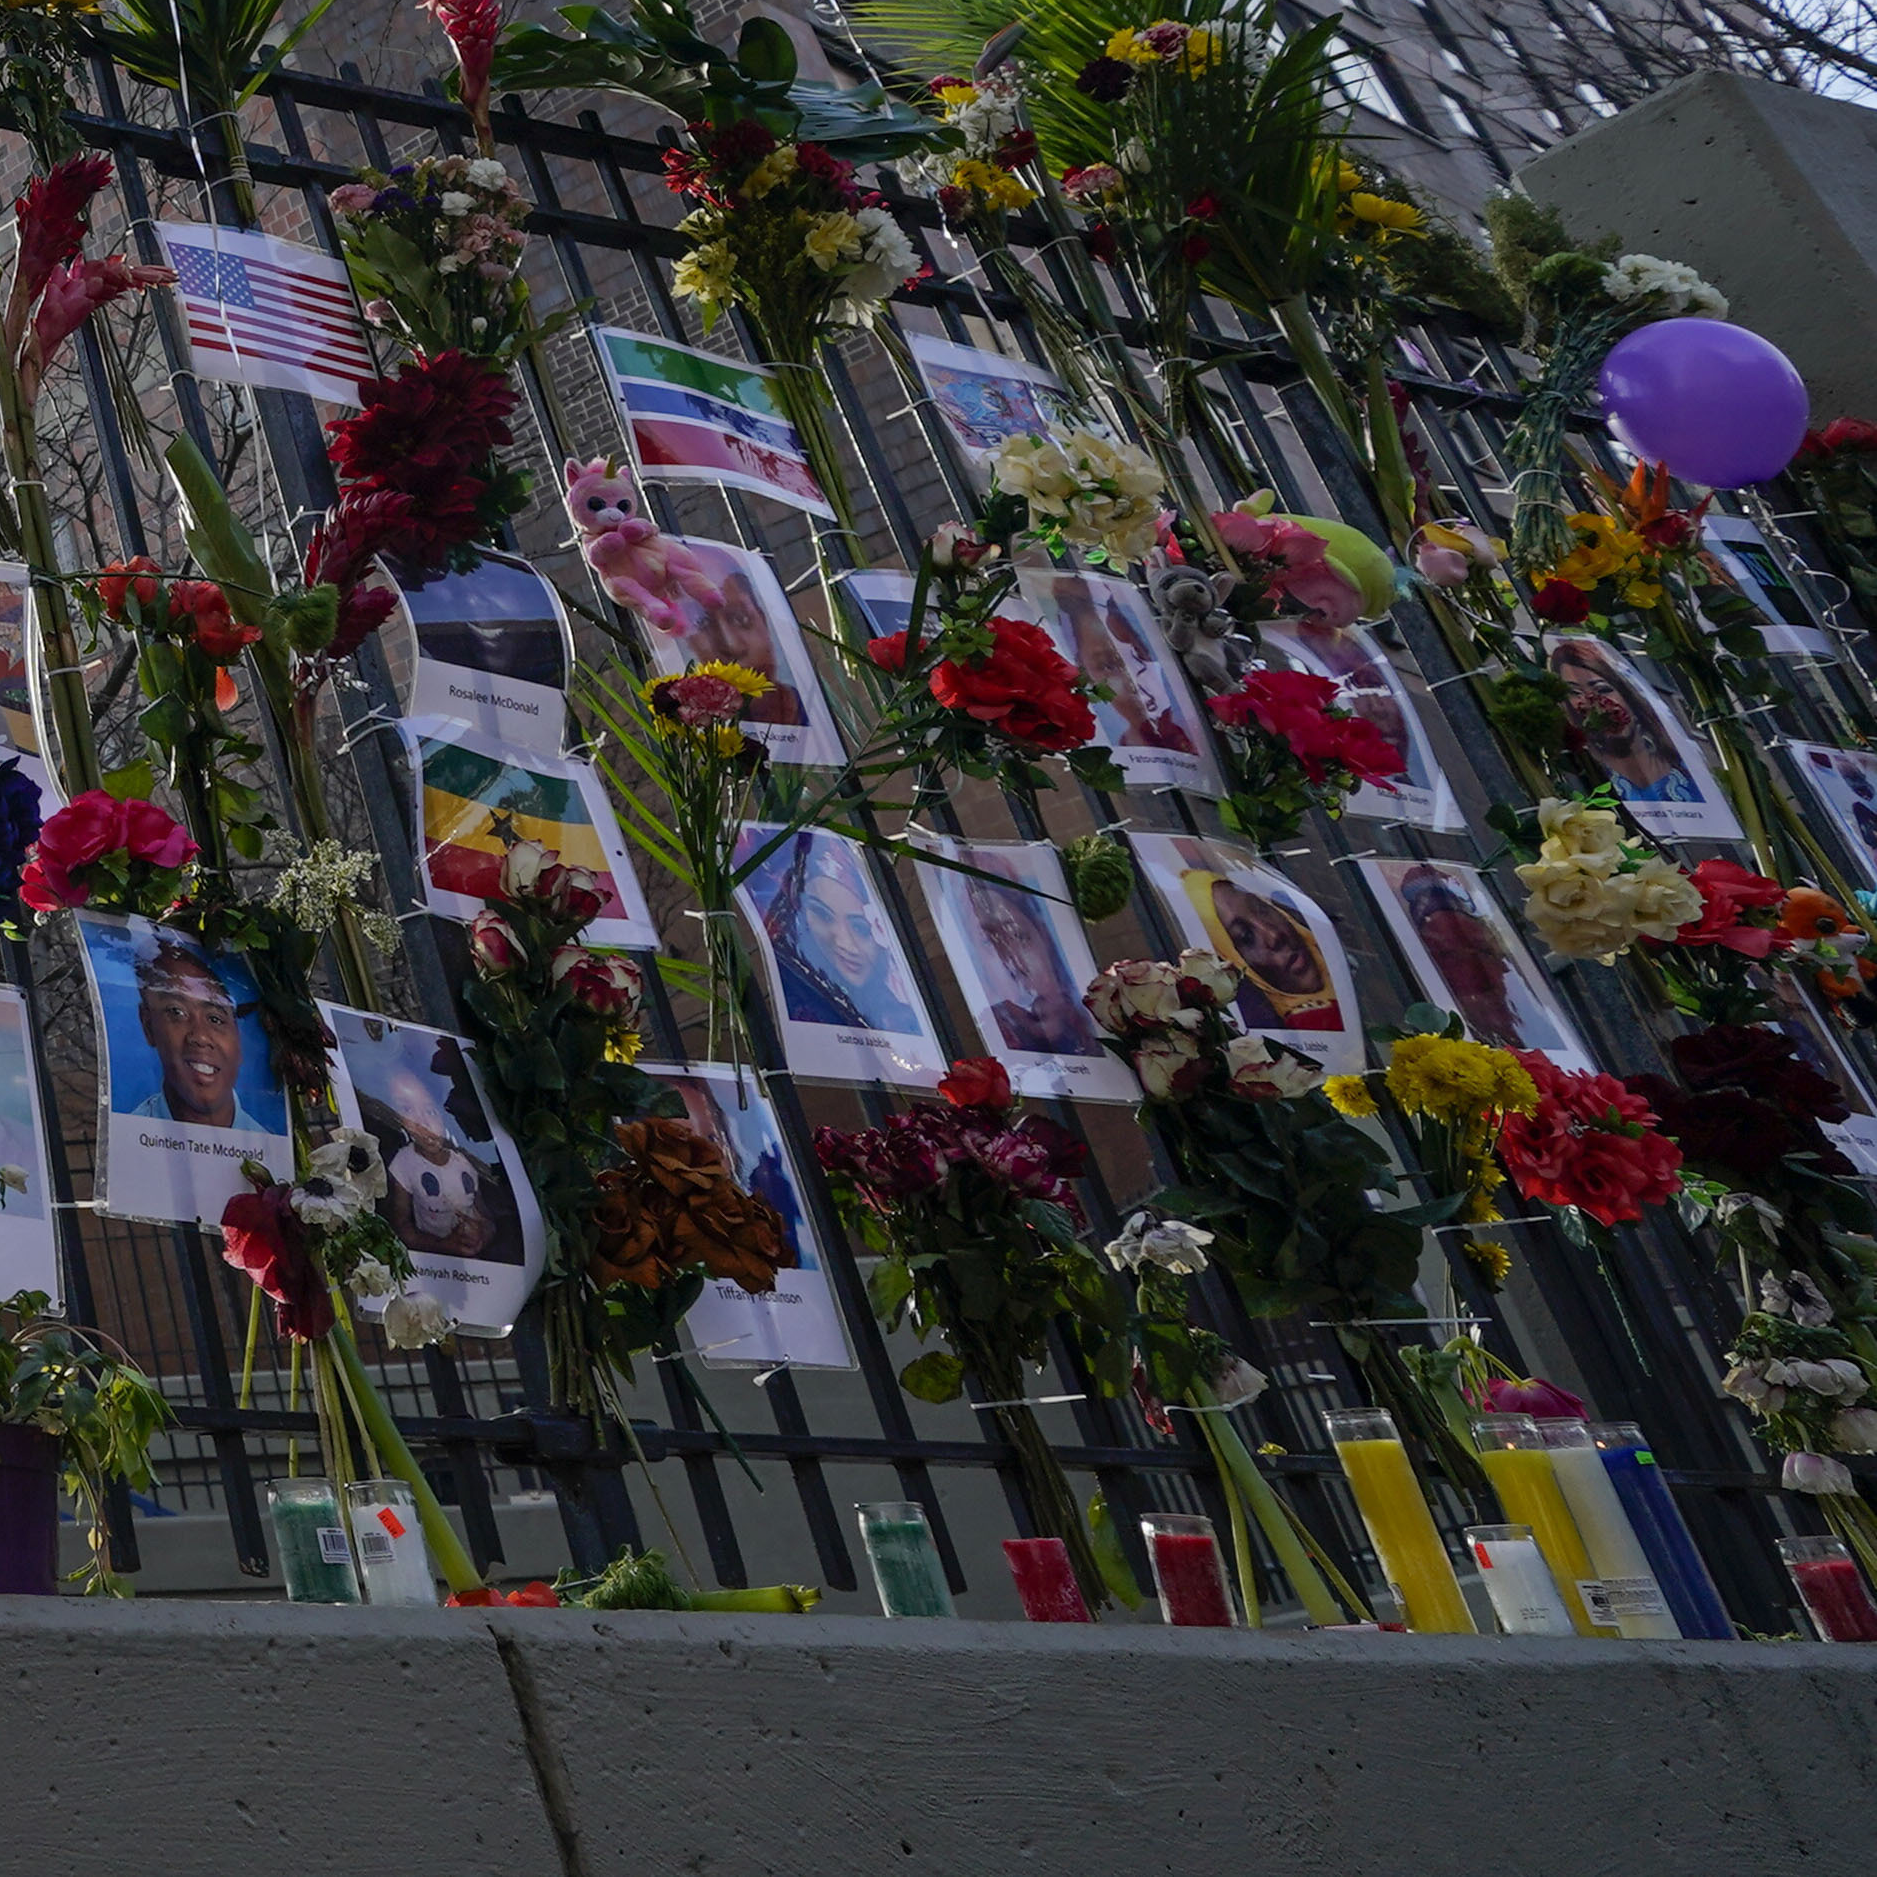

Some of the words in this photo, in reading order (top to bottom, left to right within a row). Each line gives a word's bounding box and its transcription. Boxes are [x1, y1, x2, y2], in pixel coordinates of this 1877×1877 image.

[449, 684, 488, 705] Rosalee
[490, 694, 540, 716] McDonald
[140, 1133, 185, 1152] Quintien
[188, 1139, 210, 1155] Tate
[212, 1143, 264, 1162] Mcdonald
[452, 1269, 490, 1286] Roberts
